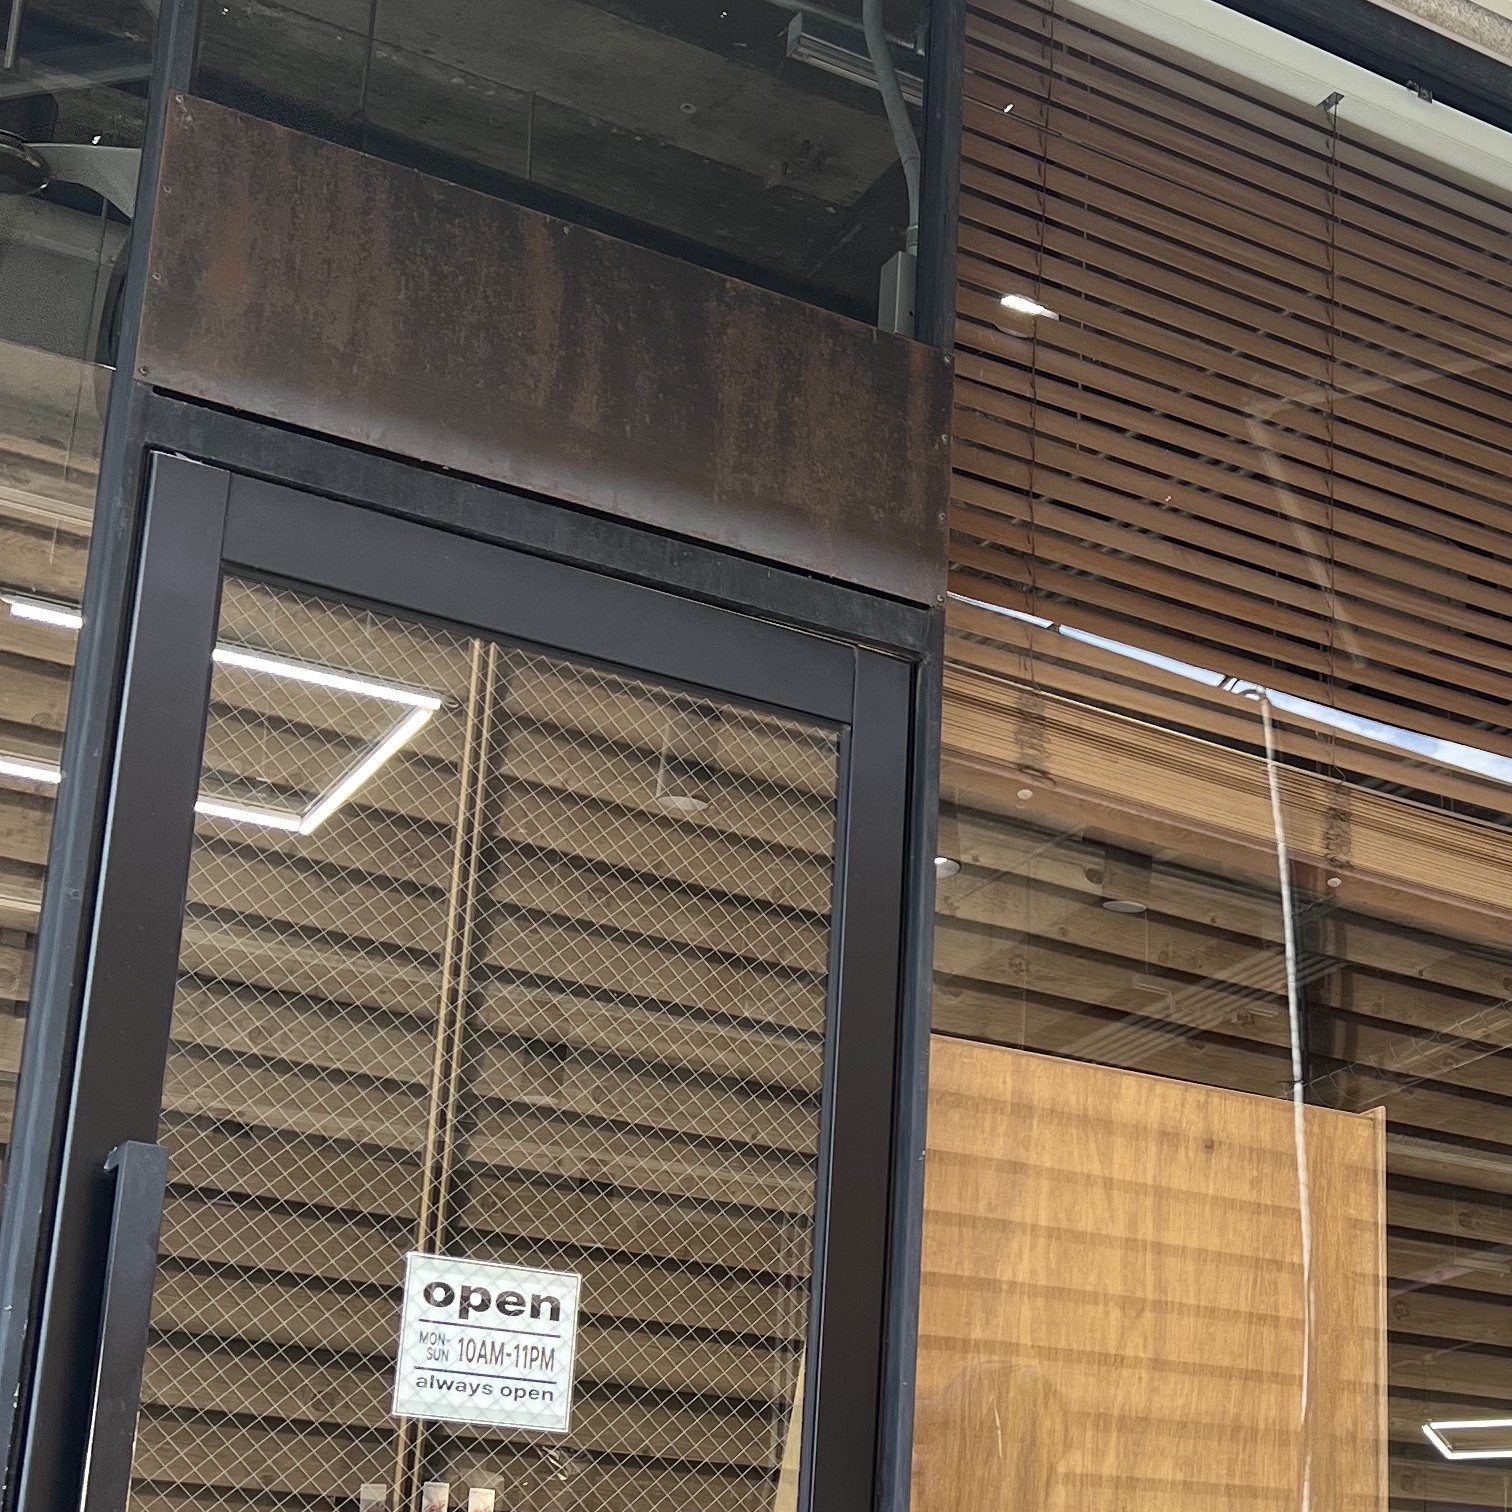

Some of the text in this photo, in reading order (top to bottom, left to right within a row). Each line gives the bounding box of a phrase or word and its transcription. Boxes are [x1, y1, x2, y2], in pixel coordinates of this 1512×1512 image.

[423, 1281, 561, 1321] open
[427, 1347, 449, 1362] SUN
[458, 1337, 555, 1371] 10AM-11PM
[416, 1375, 553, 1401] always open
